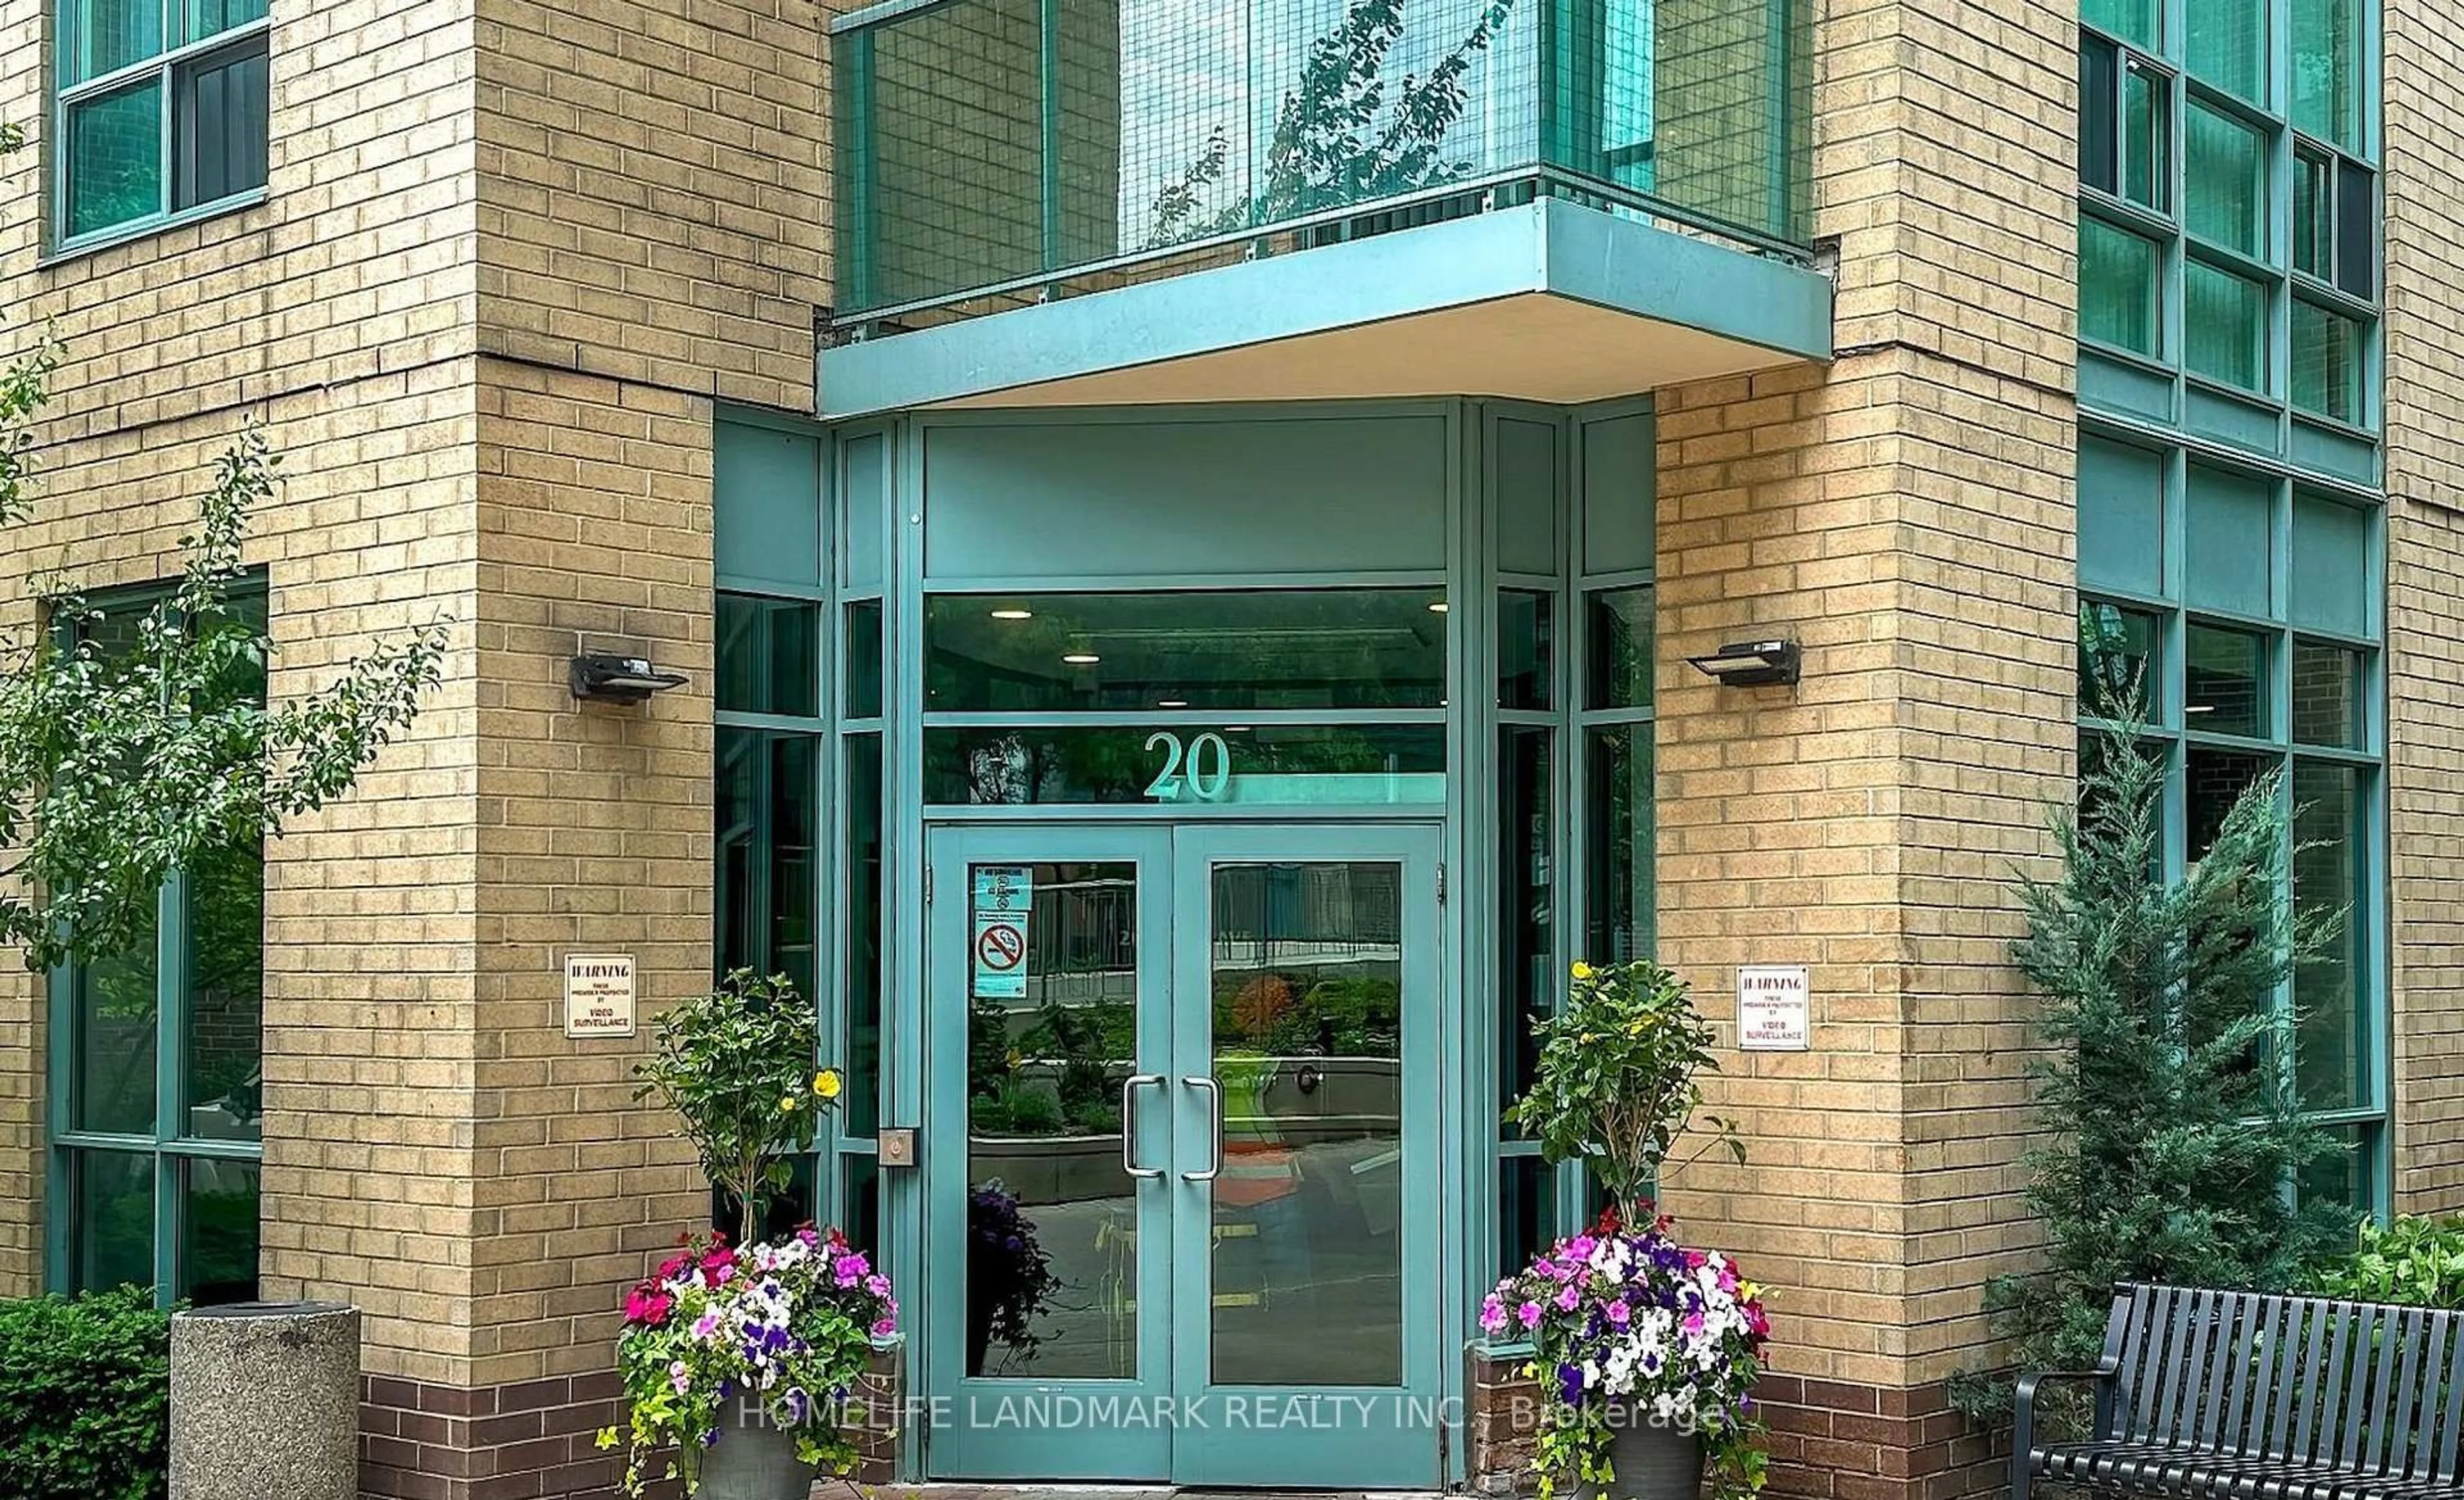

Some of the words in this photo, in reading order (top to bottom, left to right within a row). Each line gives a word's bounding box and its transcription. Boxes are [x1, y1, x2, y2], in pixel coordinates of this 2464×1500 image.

[1144, 732, 1230, 799] 20
[572, 965, 629, 977] WARNING
[1744, 978, 1801, 989] WARNING
[590, 1008, 613, 1017] VIDEO
